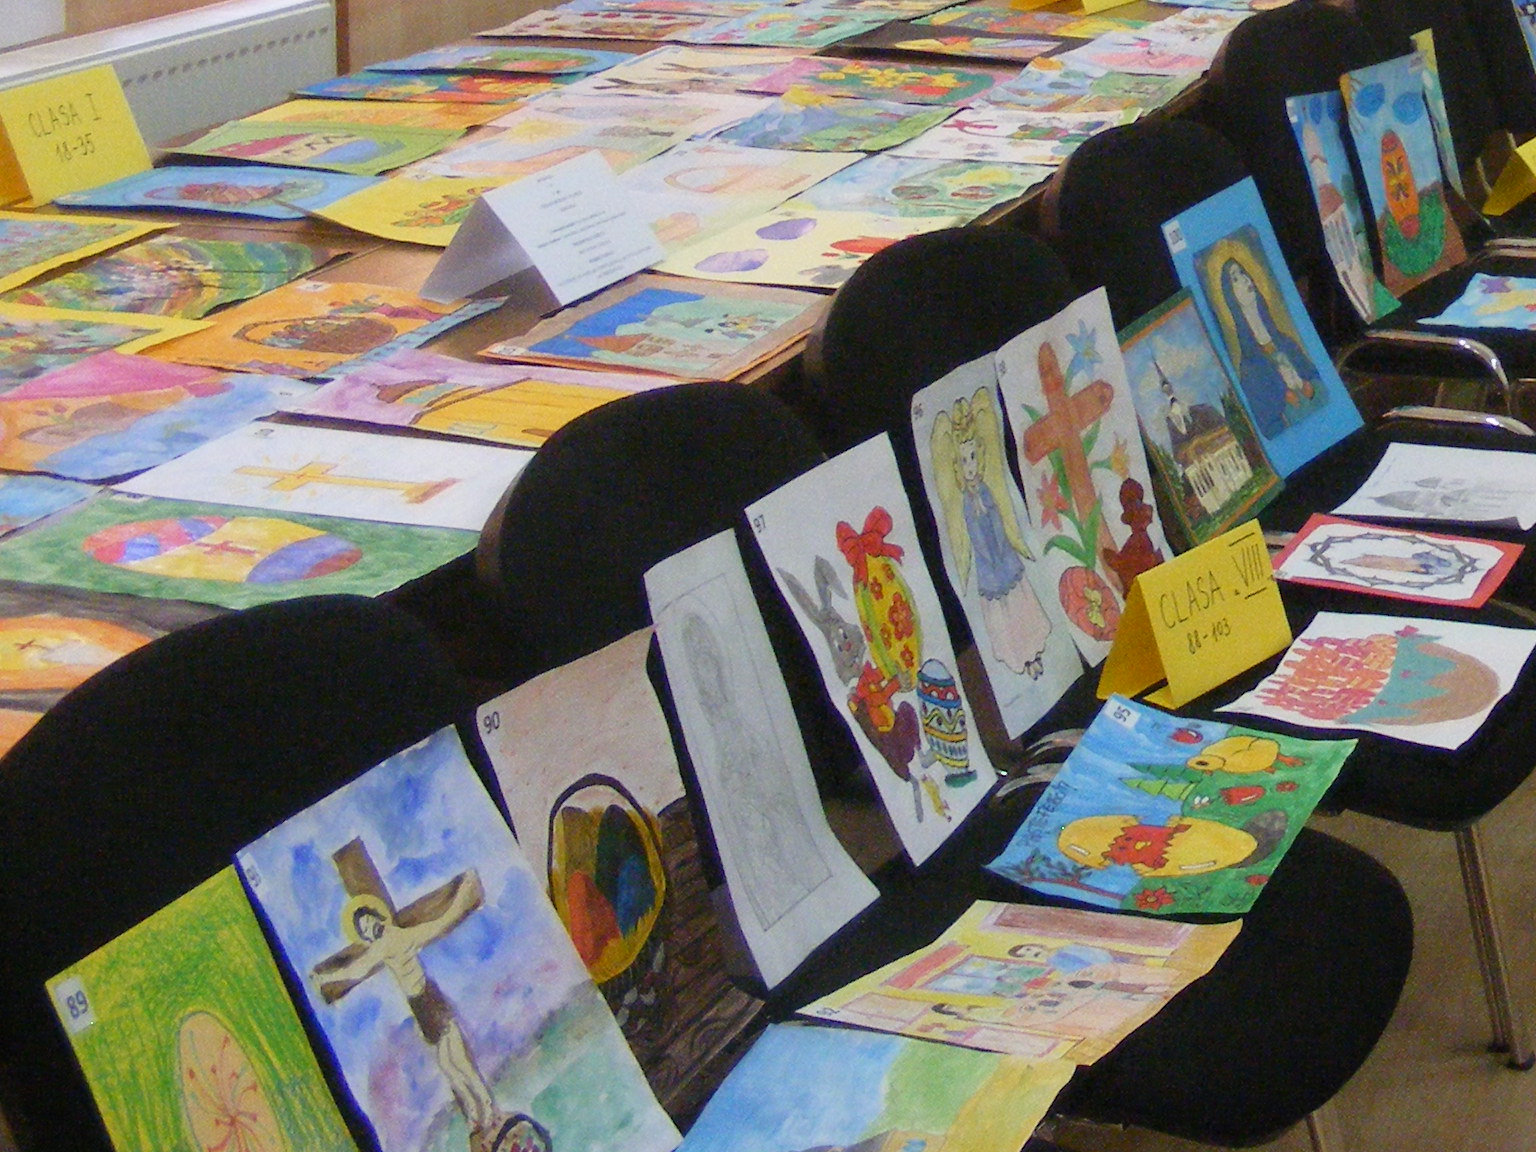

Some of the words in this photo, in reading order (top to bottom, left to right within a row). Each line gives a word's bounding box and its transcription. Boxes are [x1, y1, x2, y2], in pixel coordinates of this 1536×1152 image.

[28, 102, 82, 138] CLASA
[84, 92, 102, 122] I
[55, 132, 96, 163] 18-35
[753, 513, 767, 534] 97
[1159, 570, 1225, 629] CLASA
[1186, 617, 1232, 655] 88-103
[482, 711, 501, 734] 90
[1113, 705, 1132, 724] 95
[65, 989, 89, 1021] 89
